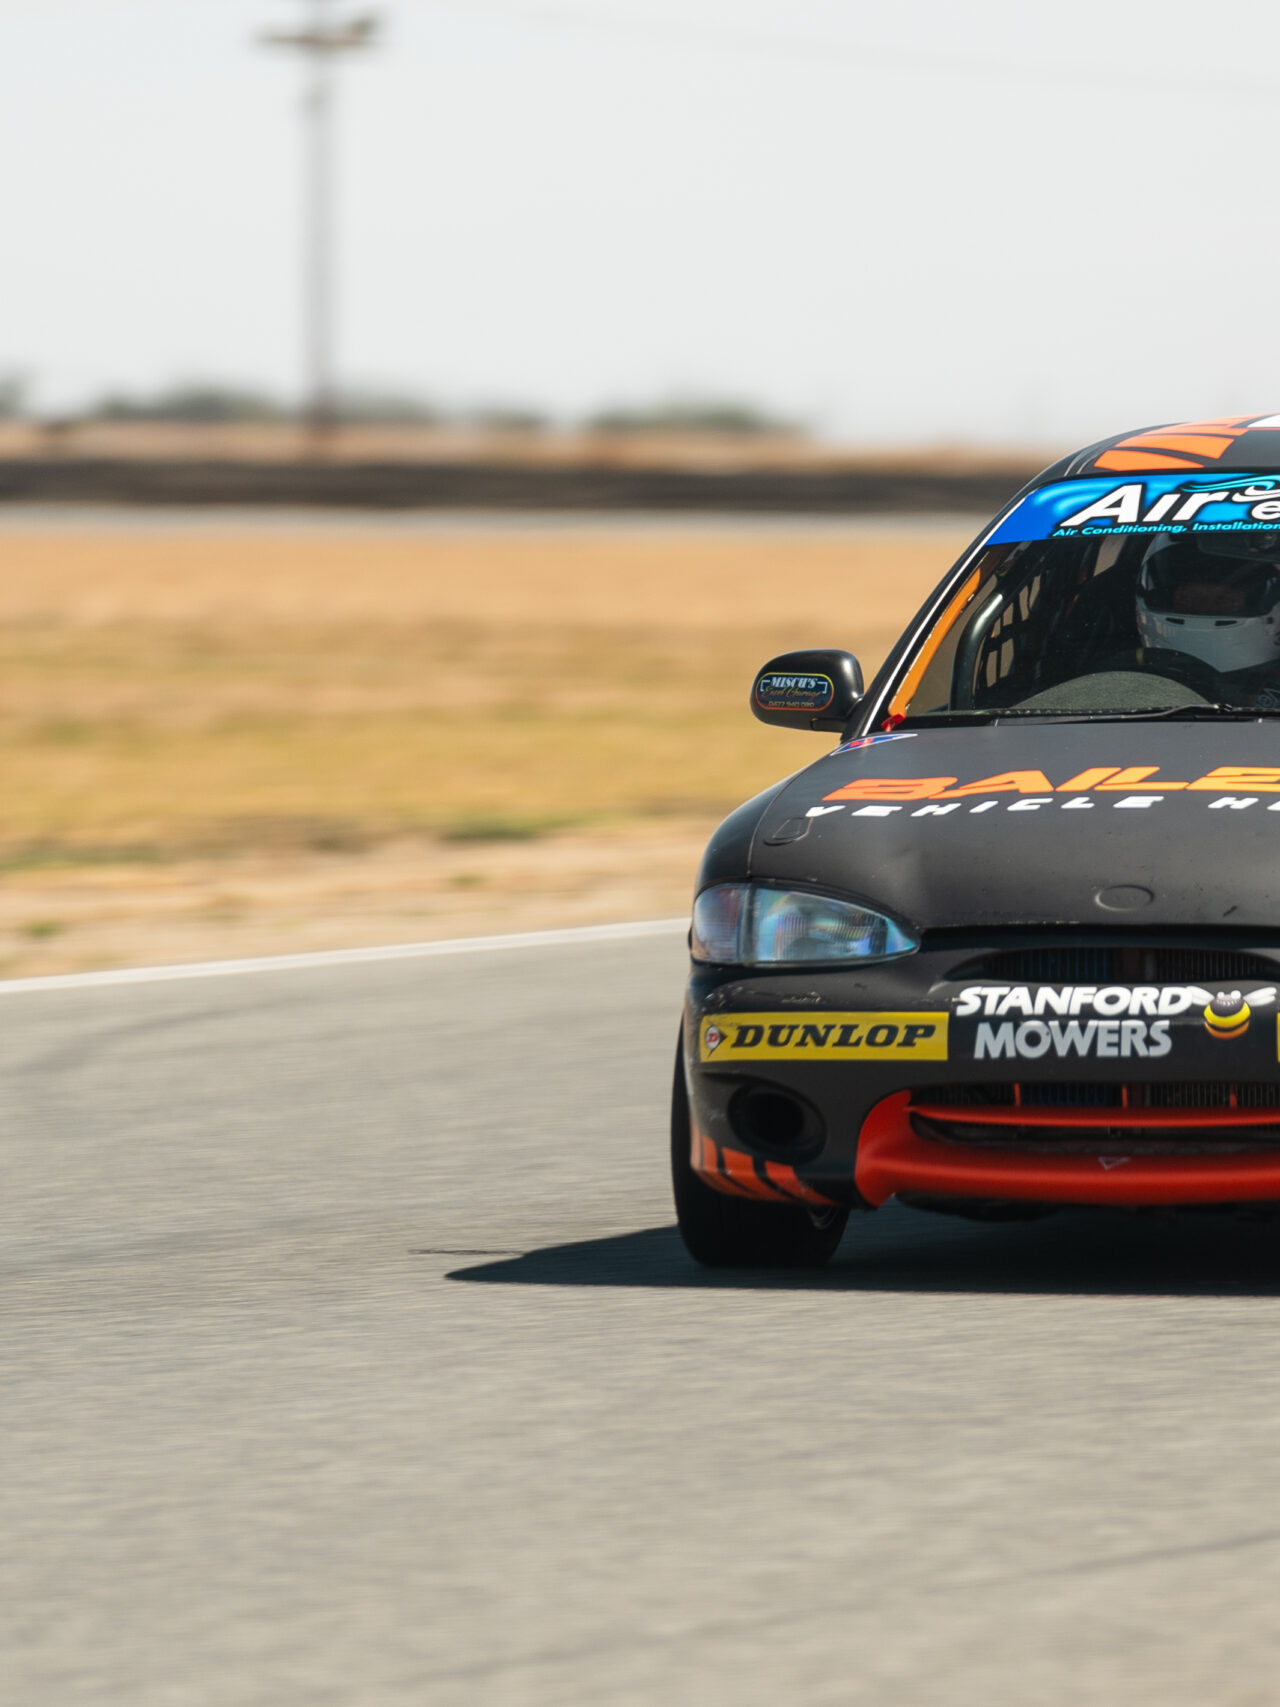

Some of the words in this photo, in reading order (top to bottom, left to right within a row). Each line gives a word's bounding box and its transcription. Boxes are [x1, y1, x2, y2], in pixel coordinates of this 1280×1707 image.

[1061, 484, 1228, 530] Air
[1051, 527, 1079, 538] Air
[1081, 523, 1188, 536] Conditioning,
[804, 796, 1165, 817] VEHICLE
[955, 985, 1196, 1017] STANFORD
[730, 1023, 937, 1049] DUNLOP
[973, 1019, 1174, 1060] MOWERS
